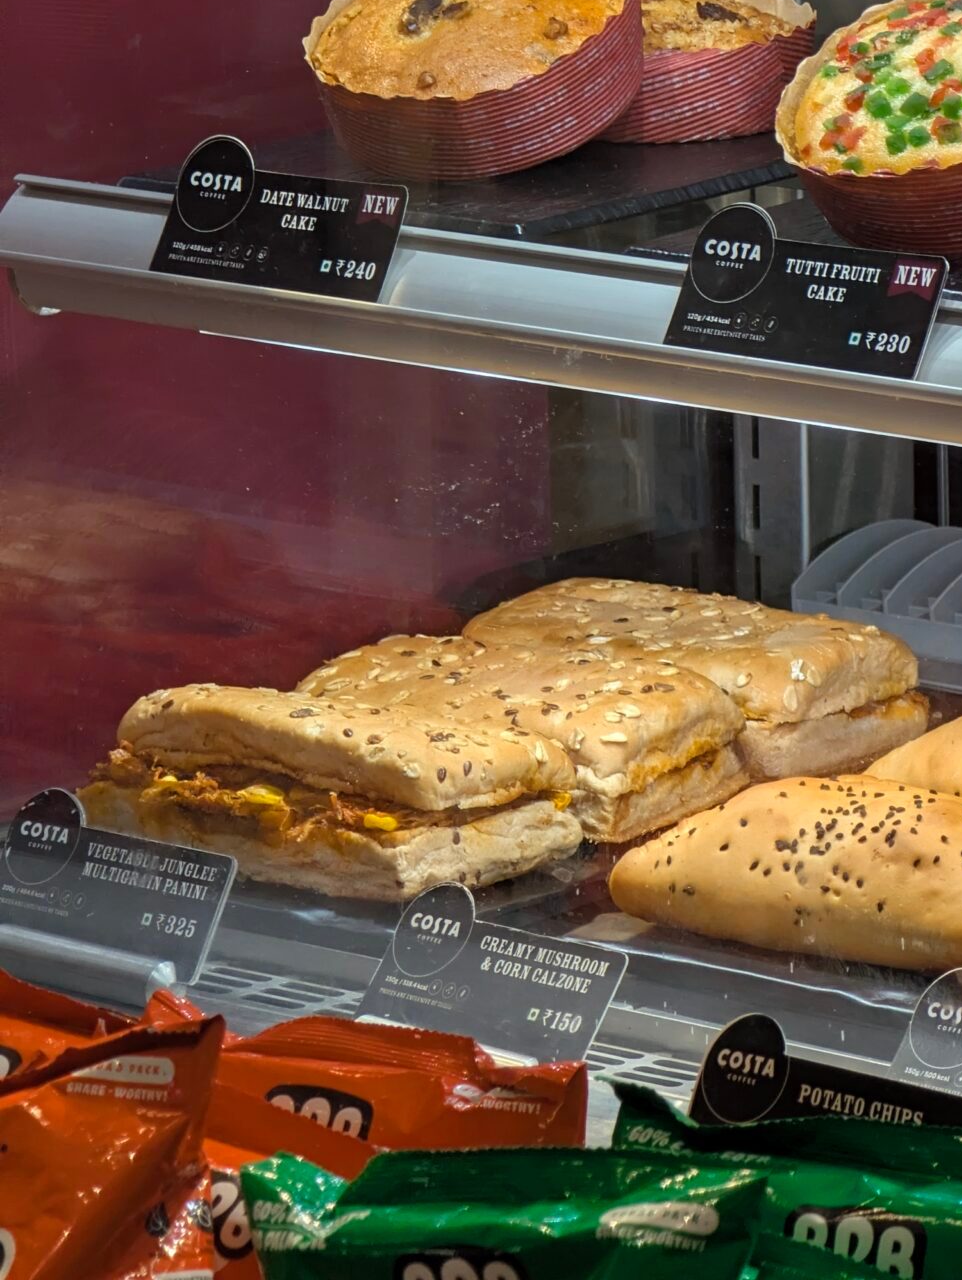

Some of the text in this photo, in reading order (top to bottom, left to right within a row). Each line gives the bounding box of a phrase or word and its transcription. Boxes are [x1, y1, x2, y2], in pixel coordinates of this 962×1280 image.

[190, 171, 243, 193] COSTA
[200, 191, 226, 200] COFFEE
[260, 189, 349, 213] DATE WALNUT
[362, 194, 400, 216] NEW
[280, 214, 317, 232] CAKE
[704, 238, 761, 262] COSTA
[335, 259, 376, 281] ₹240
[715, 260, 744, 270] COFFEE
[786, 257, 882, 284] TUTTI FRUITI
[894, 265, 937, 288] NEW
[807, 284, 847, 303] CAKE
[866, 331, 911, 355] ₹230
[20, 820, 69, 844] COSTA
[159, 855, 218, 882] JUNGLEE
[82, 861, 208, 901] MULTIGRAIN PANINI
[156, 913, 197, 938] ₹325
[410, 912, 461, 938] COSTA
[417, 933, 442, 945] COFFEE
[480, 935, 610, 978] CREAMY MUSHROOM
[480, 956, 592, 994] & CORN CALZONE
[542, 1008, 582, 1034] ₹150
[717, 1048, 775, 1078] COSTA
[727, 1073, 756, 1086] COFFEE
[797, 1083, 866, 1116] POTATO
[869, 1101, 924, 1125] CHIPS
[628, 1124, 671, 1147] 60%
